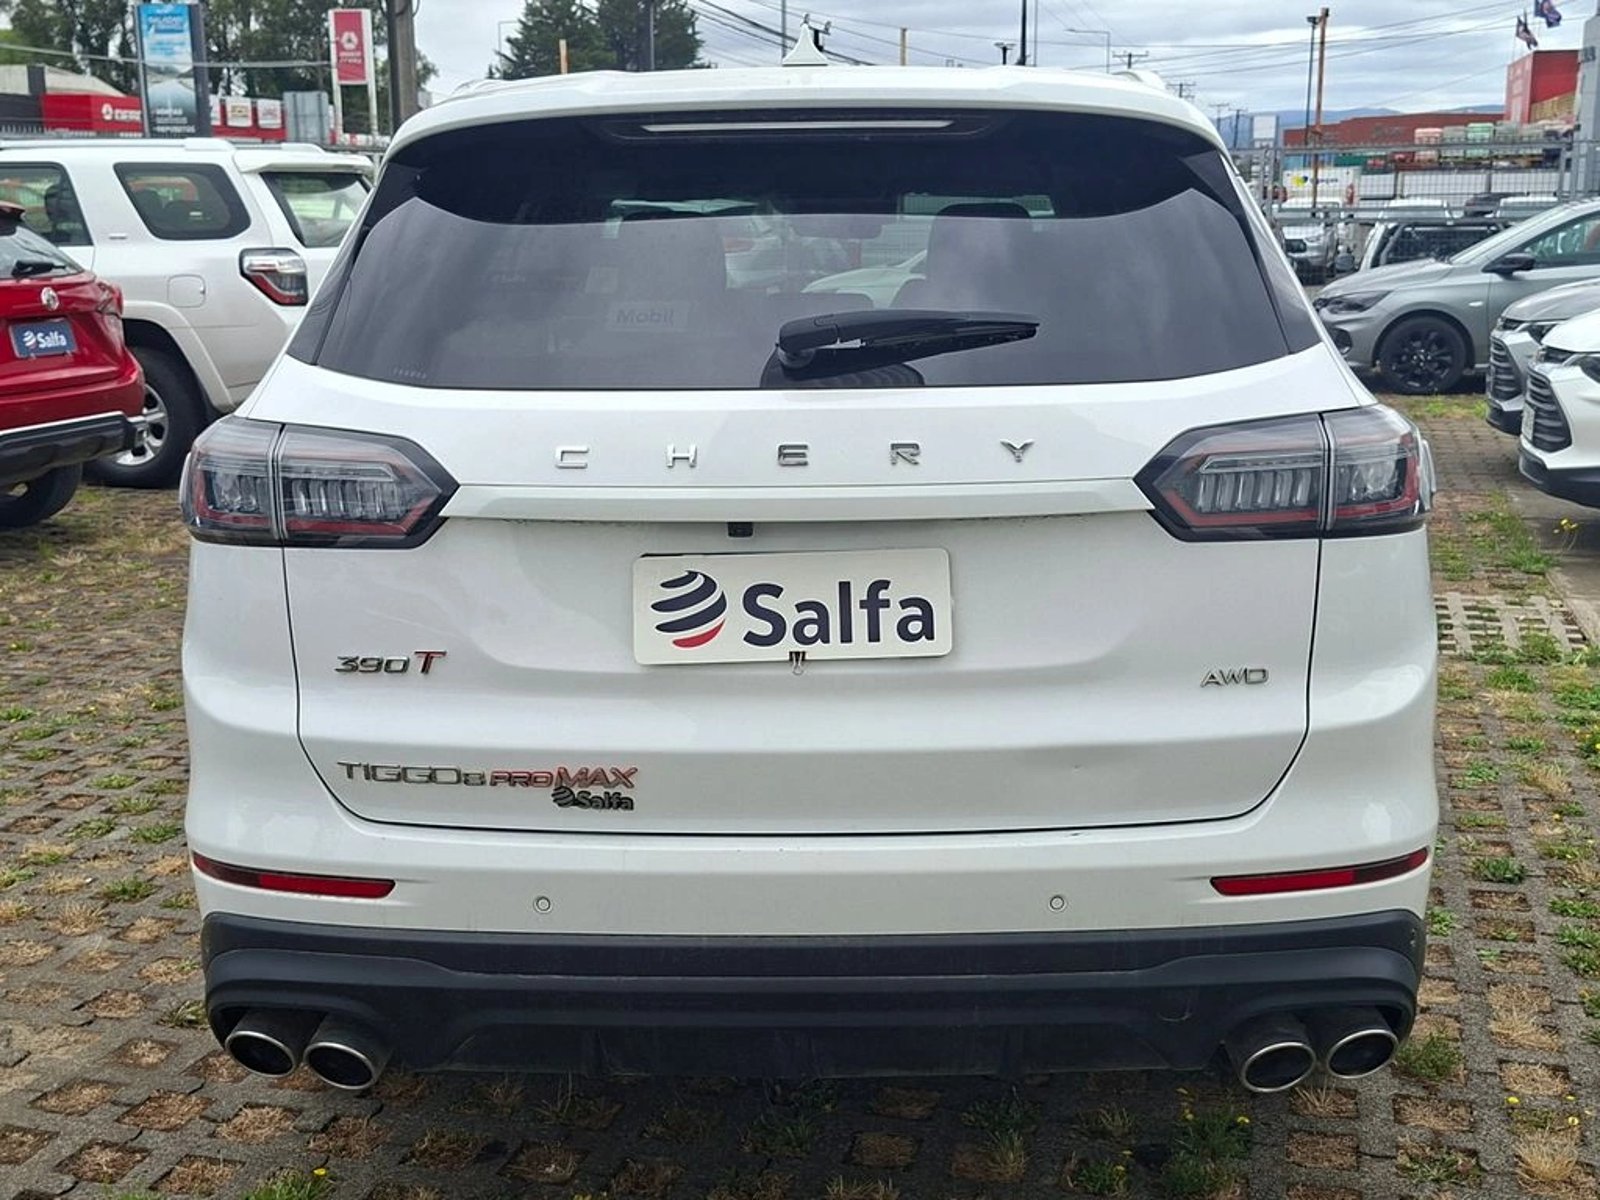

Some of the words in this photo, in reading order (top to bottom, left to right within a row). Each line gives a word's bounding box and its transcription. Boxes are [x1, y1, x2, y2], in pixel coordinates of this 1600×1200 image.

[616, 309, 675, 326] Mobil
[36, 330, 68, 349] Salfa
[554, 439, 1036, 470] CHERY
[741, 579, 936, 648] Salfa
[1200, 667, 1269, 688] AWD
[577, 789, 635, 812] Salfa
